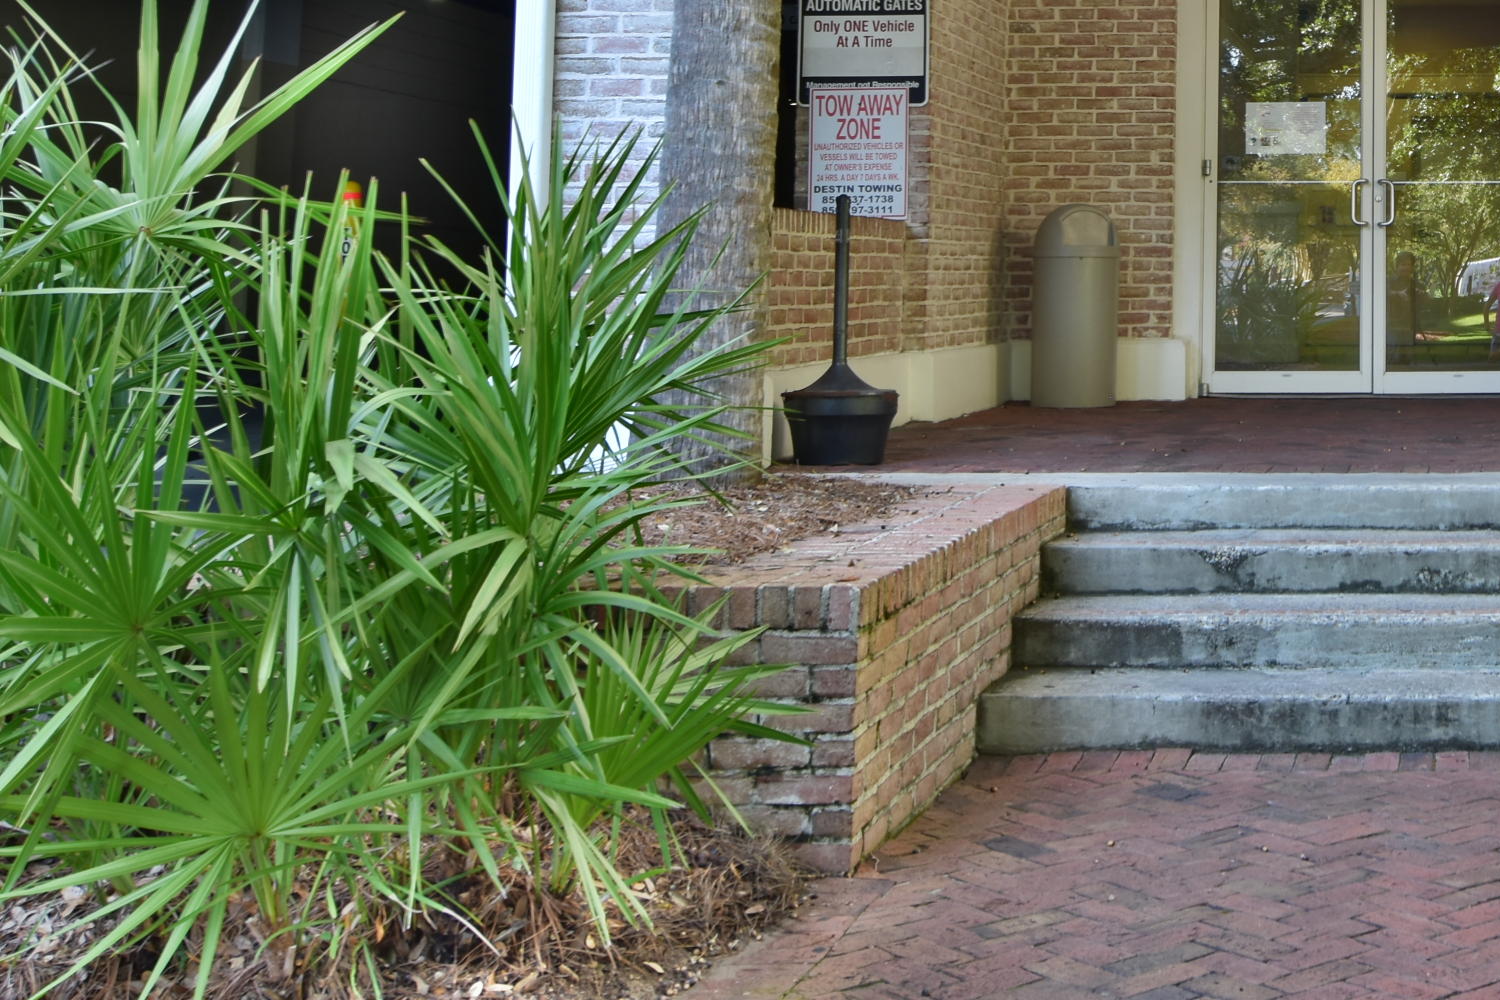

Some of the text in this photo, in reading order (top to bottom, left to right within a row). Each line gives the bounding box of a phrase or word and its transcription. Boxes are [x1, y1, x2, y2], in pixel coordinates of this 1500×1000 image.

[814, 20, 915, 35] Only ONE Vehicle
[836, 35, 893, 48] At A Time
[815, 94, 903, 117] TOW AWAY
[836, 117, 881, 140] ZONE
[814, 142, 904, 151] UNAUTHORIZED VEHICLES OR
[820, 152, 848, 161] VESSELS
[849, 153, 864, 161] WILL
[875, 152, 898, 160] TOWED
[824, 162, 893, 171] AT OWNER'S EXPENSE
[816, 174, 824, 182] 24
[864, 173, 881, 181] DAYS
[814, 184, 903, 194] DESTIN TOWING
[822, 195, 894, 204] 8537-1738
